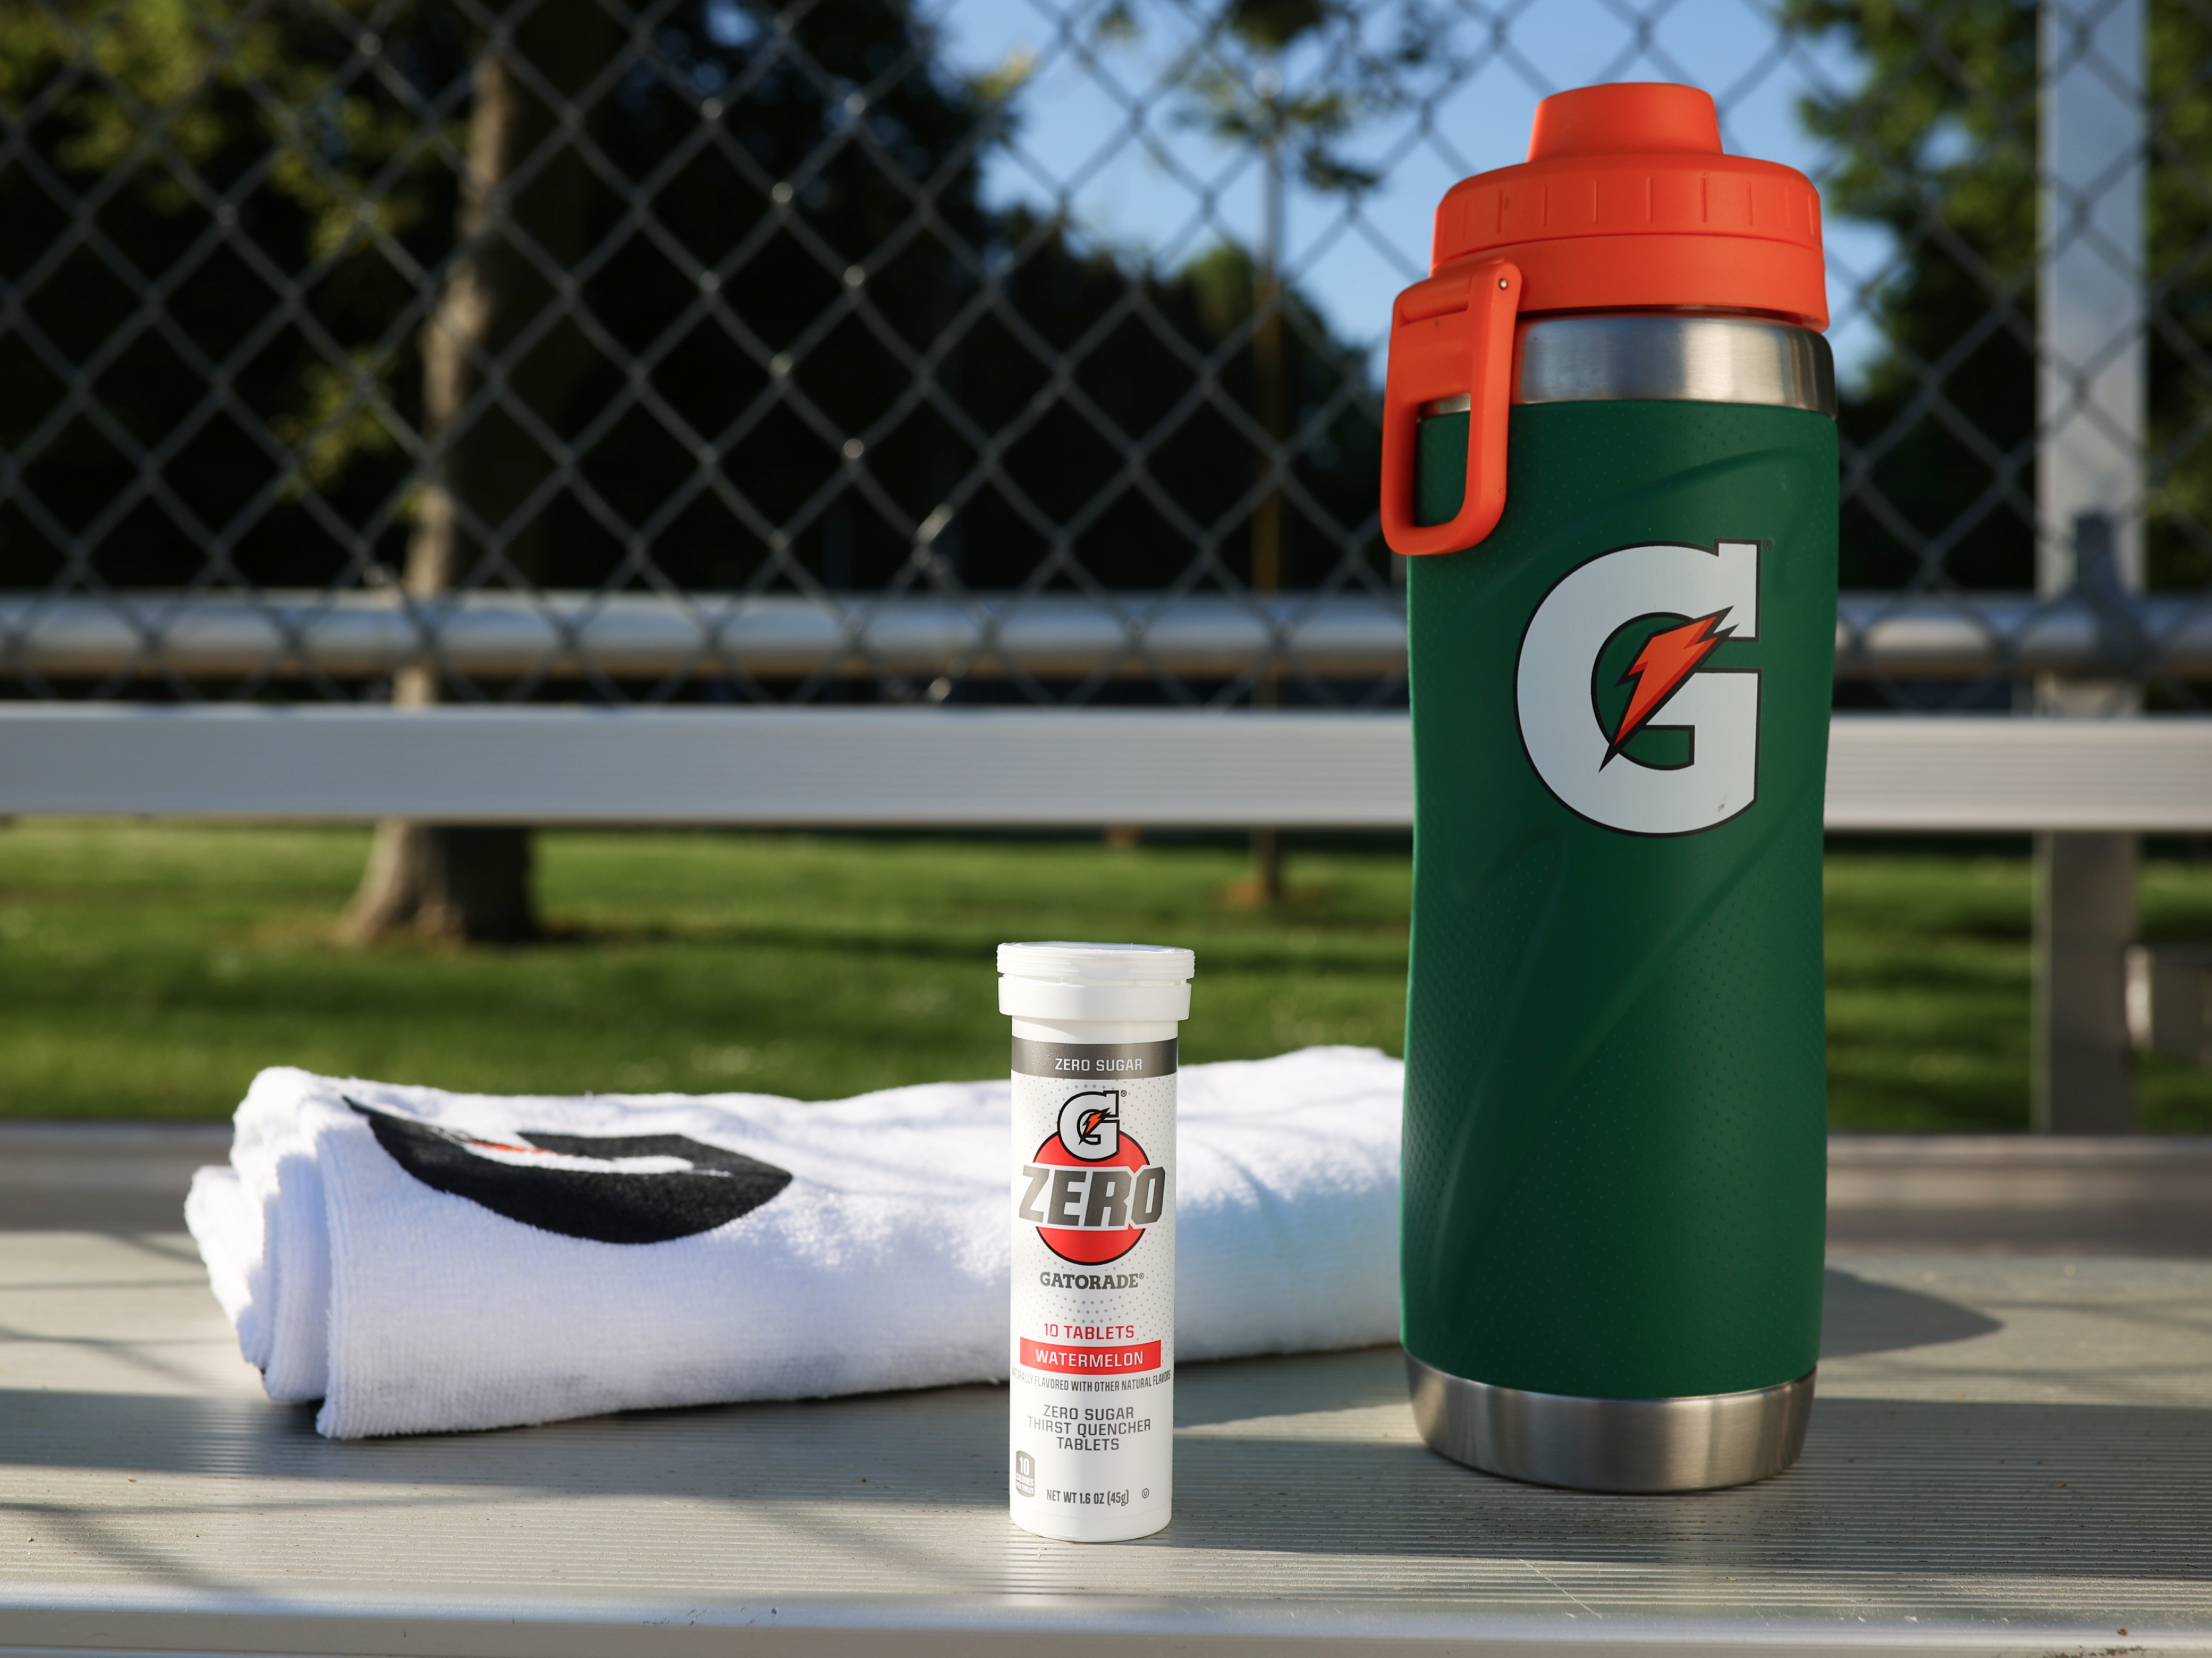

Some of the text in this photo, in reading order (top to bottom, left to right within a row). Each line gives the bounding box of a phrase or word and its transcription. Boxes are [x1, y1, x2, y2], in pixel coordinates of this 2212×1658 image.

[1055, 1058, 1143, 1071] ZERO SUGAR
[1018, 1164, 1166, 1227] ZERO
[1043, 1322, 1135, 1340] 10 TABLETS
[1035, 1348, 1144, 1368] WATERMELON
[1034, 1376, 1069, 1391] FLAVORED
[1071, 1379, 1092, 1393] WITH
[1094, 1381, 1120, 1393] OTHER
[1122, 1378, 1153, 1391] NATURAL
[1152, 1369, 1171, 1385] FLAVORS
[1043, 1404, 1134, 1421] ZERO SUGAR
[1027, 1415, 1151, 1437] THIRST QUENCHER
[1056, 1436, 1120, 1452] TABLETS
[1019, 1456, 1030, 1476] 10
[1016, 1473, 1034, 1487] CALORIES
[1021, 1483, 1034, 1495] TABLET
[1046, 1489, 1129, 1507] NET WT 1.6 OZ (45g)
